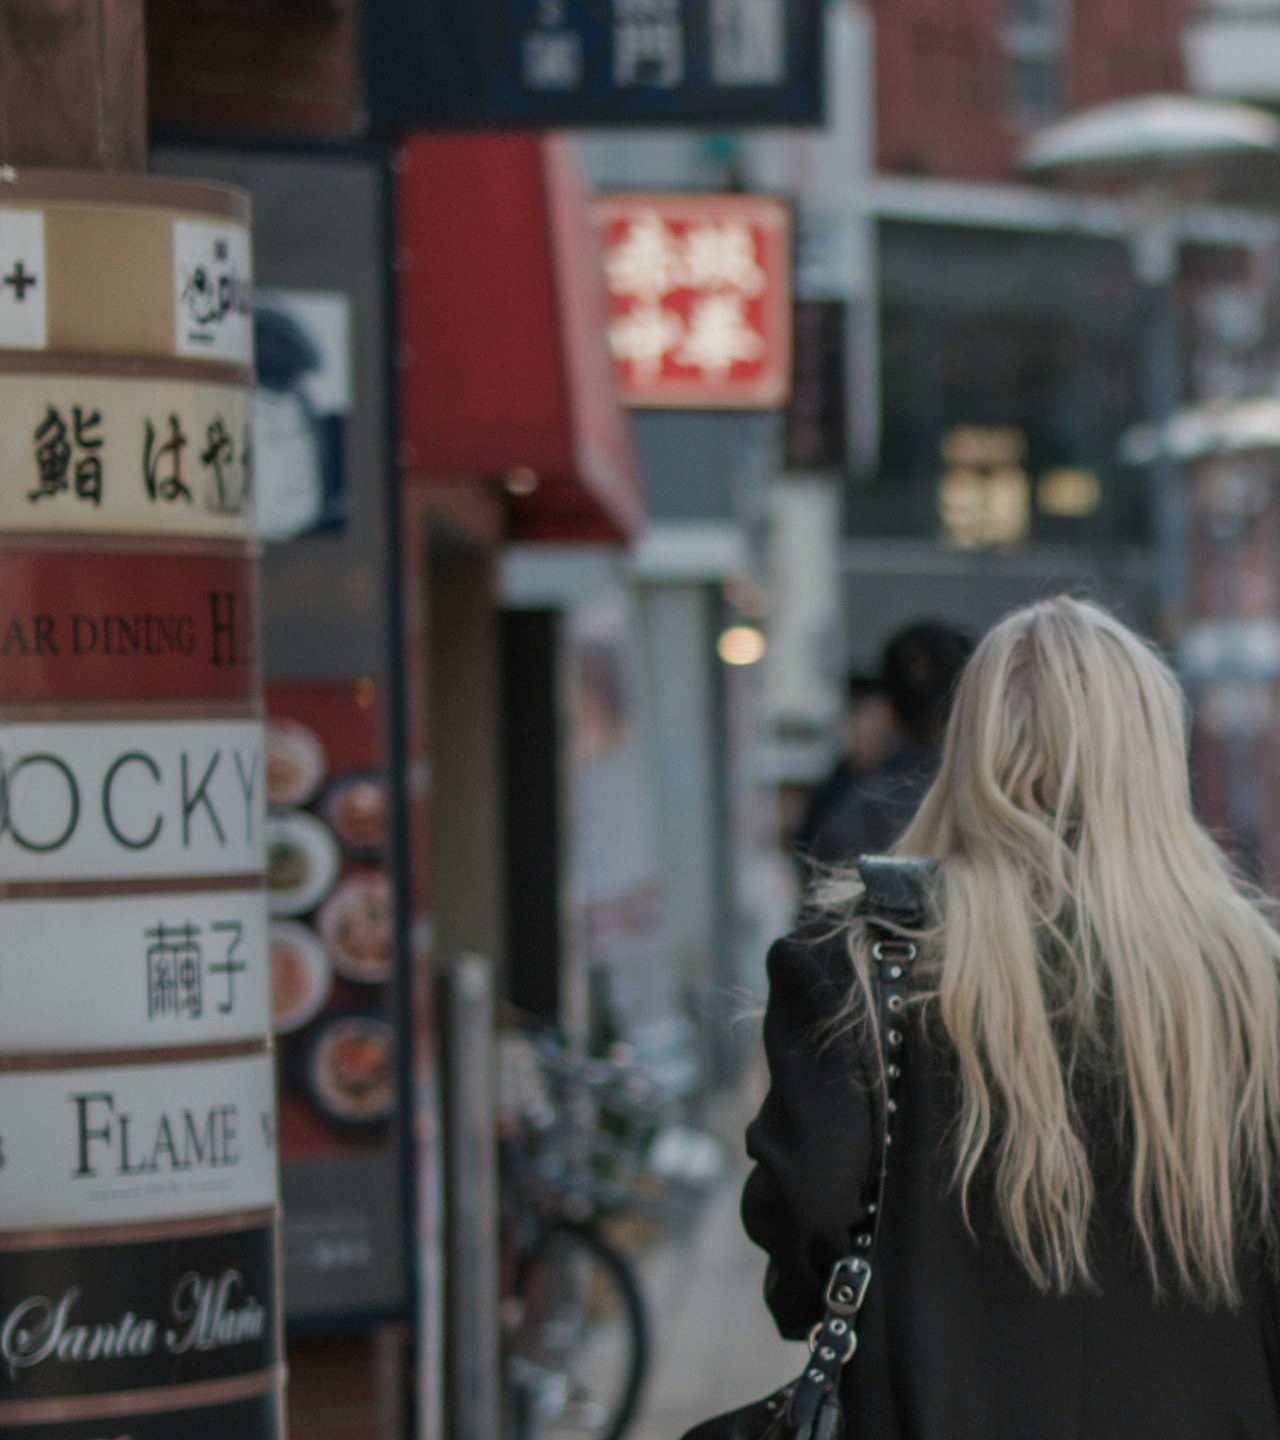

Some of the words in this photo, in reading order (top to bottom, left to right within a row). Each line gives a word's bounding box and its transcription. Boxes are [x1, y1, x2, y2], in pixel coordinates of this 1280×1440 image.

[28, 404, 105, 507] 鮨
[142, 411, 250, 513] はや
[71, 613, 195, 657] DINING
[68, 1091, 239, 1179] FLAME
[0, 1284, 157, 1381] Santa
